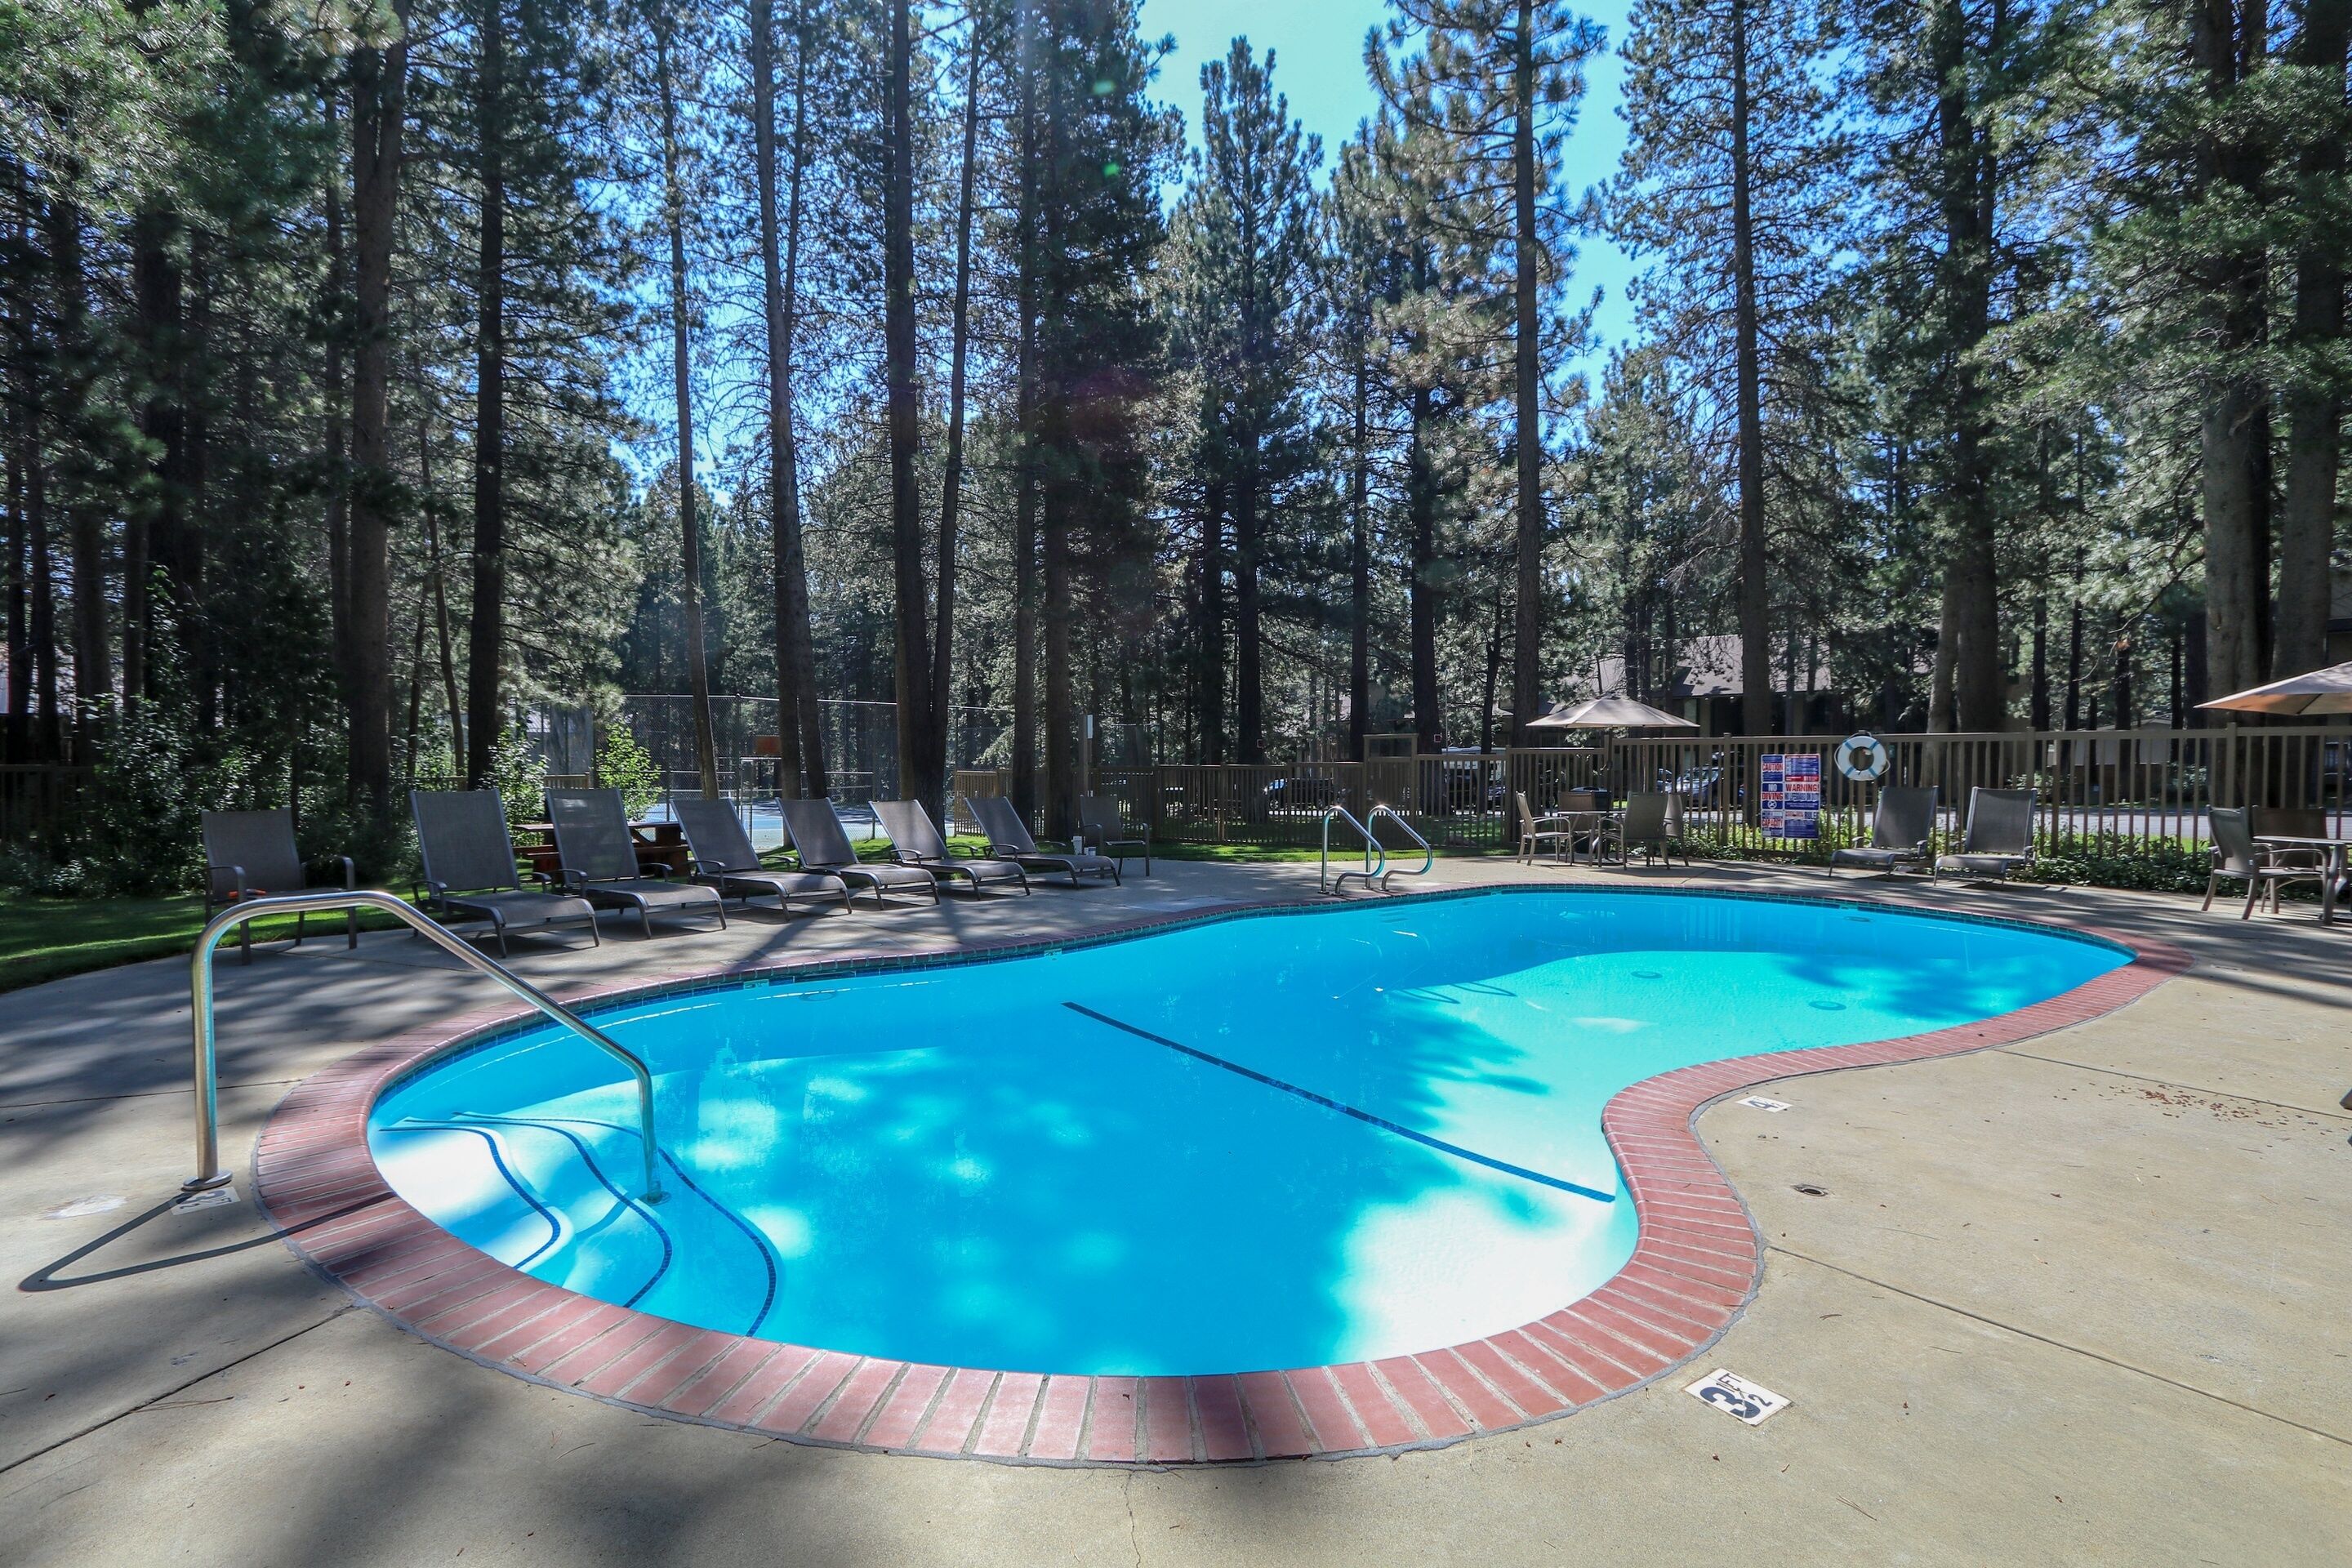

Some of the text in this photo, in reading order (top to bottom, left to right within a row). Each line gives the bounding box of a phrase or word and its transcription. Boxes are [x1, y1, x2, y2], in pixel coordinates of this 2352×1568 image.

[1762, 763, 1783, 771] CAUTION
[1786, 784, 1820, 792] WARNING!
[1762, 792, 1783, 800] DIVING
[1717, 1373, 1741, 1388] FT
[1699, 1386, 1760, 1419] 3
